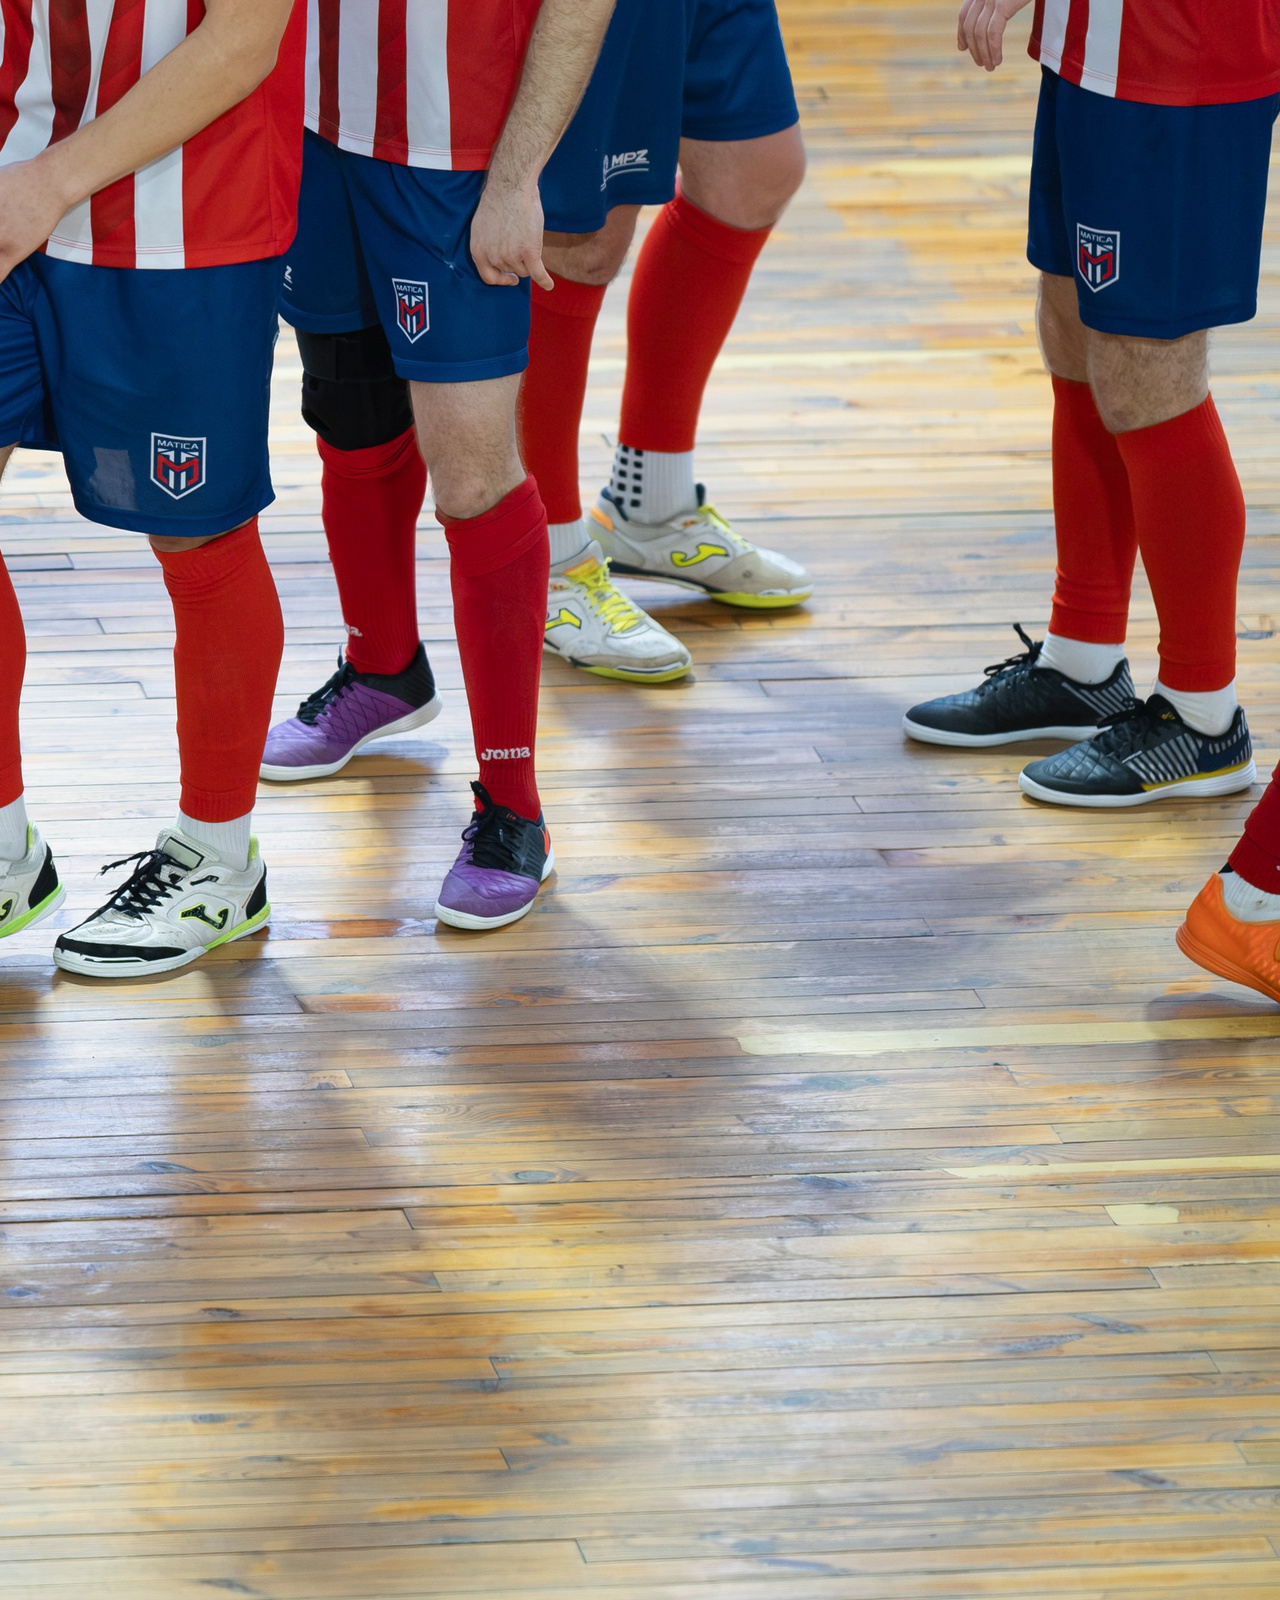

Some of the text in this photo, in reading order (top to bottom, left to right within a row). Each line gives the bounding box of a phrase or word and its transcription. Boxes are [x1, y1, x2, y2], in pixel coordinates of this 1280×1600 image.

[611, 149, 648, 167] MPZ
[1080, 230, 1113, 244] MATICA
[396, 284, 423, 294] MATICA
[157, 439, 199, 450] MATICA
[481, 746, 531, 761] Joma
